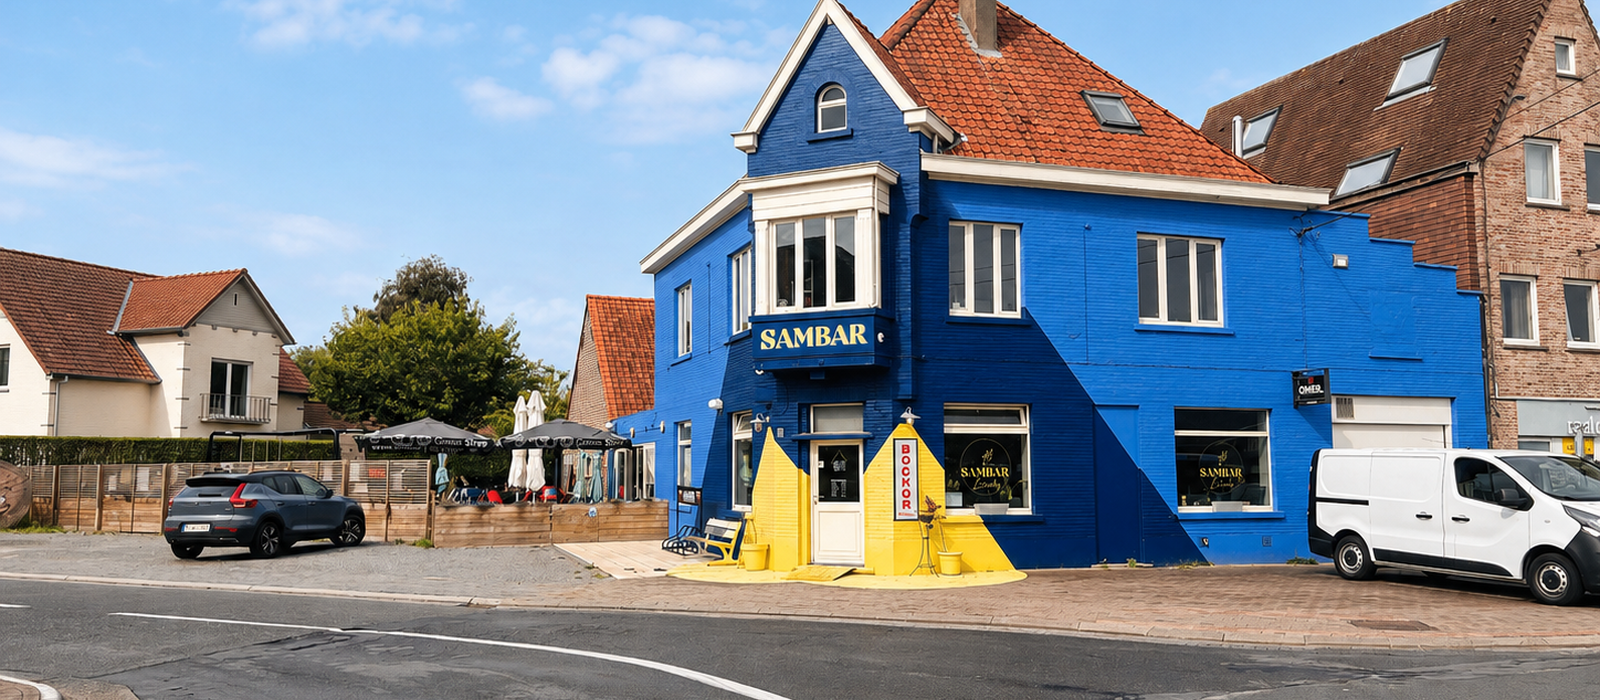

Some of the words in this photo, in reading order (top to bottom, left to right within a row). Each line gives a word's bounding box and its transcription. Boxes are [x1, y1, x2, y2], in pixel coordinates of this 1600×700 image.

[761, 323, 868, 350] SAMBAR
[901, 444, 911, 510] BOCKOR
[960, 466, 1010, 478] SAMBAR
[1199, 467, 1243, 478] SAMBAR
